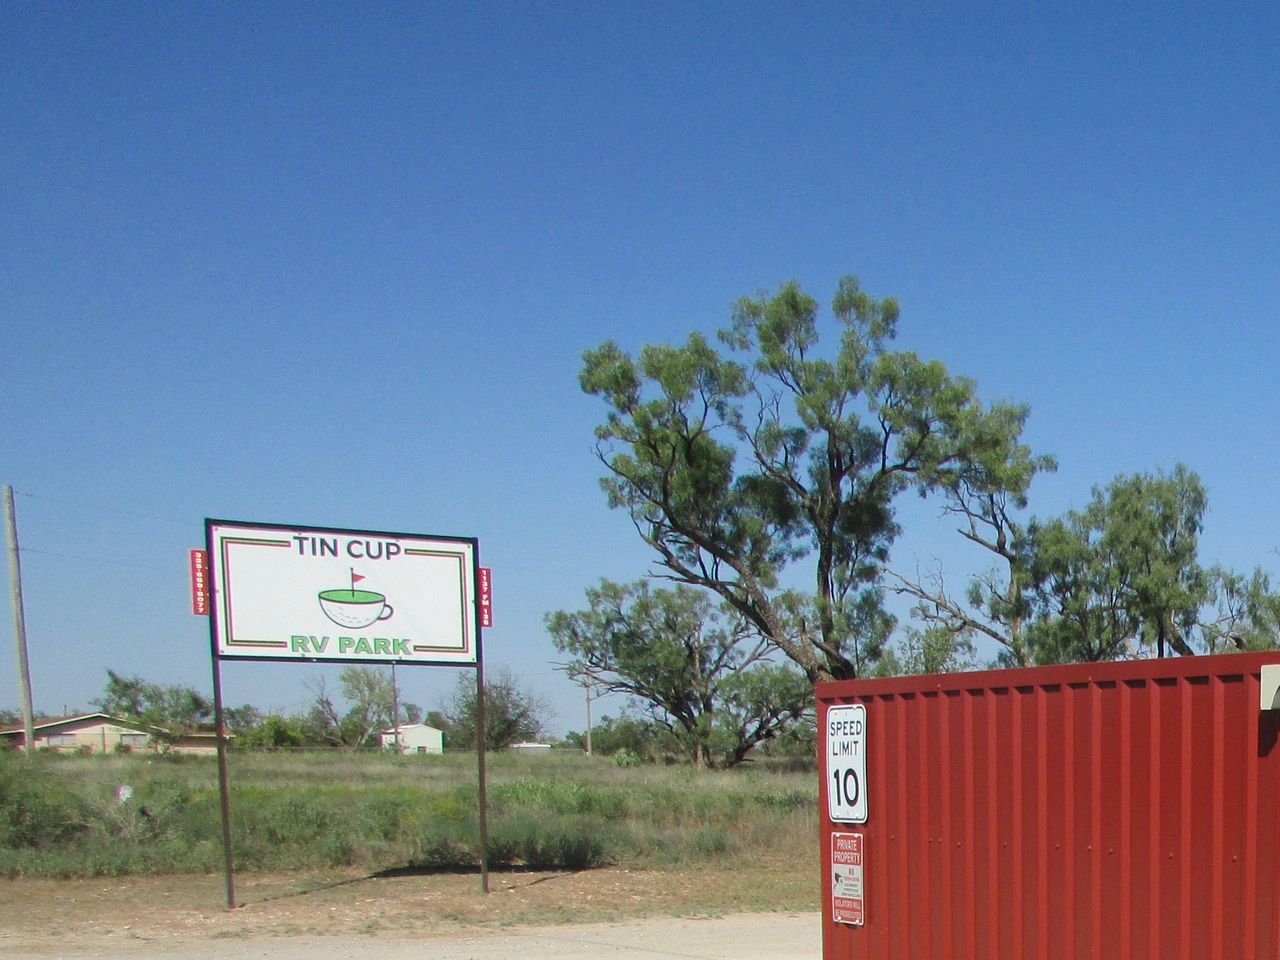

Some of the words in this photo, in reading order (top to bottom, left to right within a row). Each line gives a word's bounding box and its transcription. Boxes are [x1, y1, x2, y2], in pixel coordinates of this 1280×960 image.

[293, 536, 338, 557] TIN
[347, 540, 402, 560] CUP
[290, 635, 330, 654] RV
[339, 636, 414, 656] PARK
[830, 720, 862, 737] SPEED
[832, 740, 859, 756] LIMIT
[833, 768, 860, 807] 10
[837, 839, 857, 851] PRIVATE
[834, 852, 860, 864] PROPERTY
